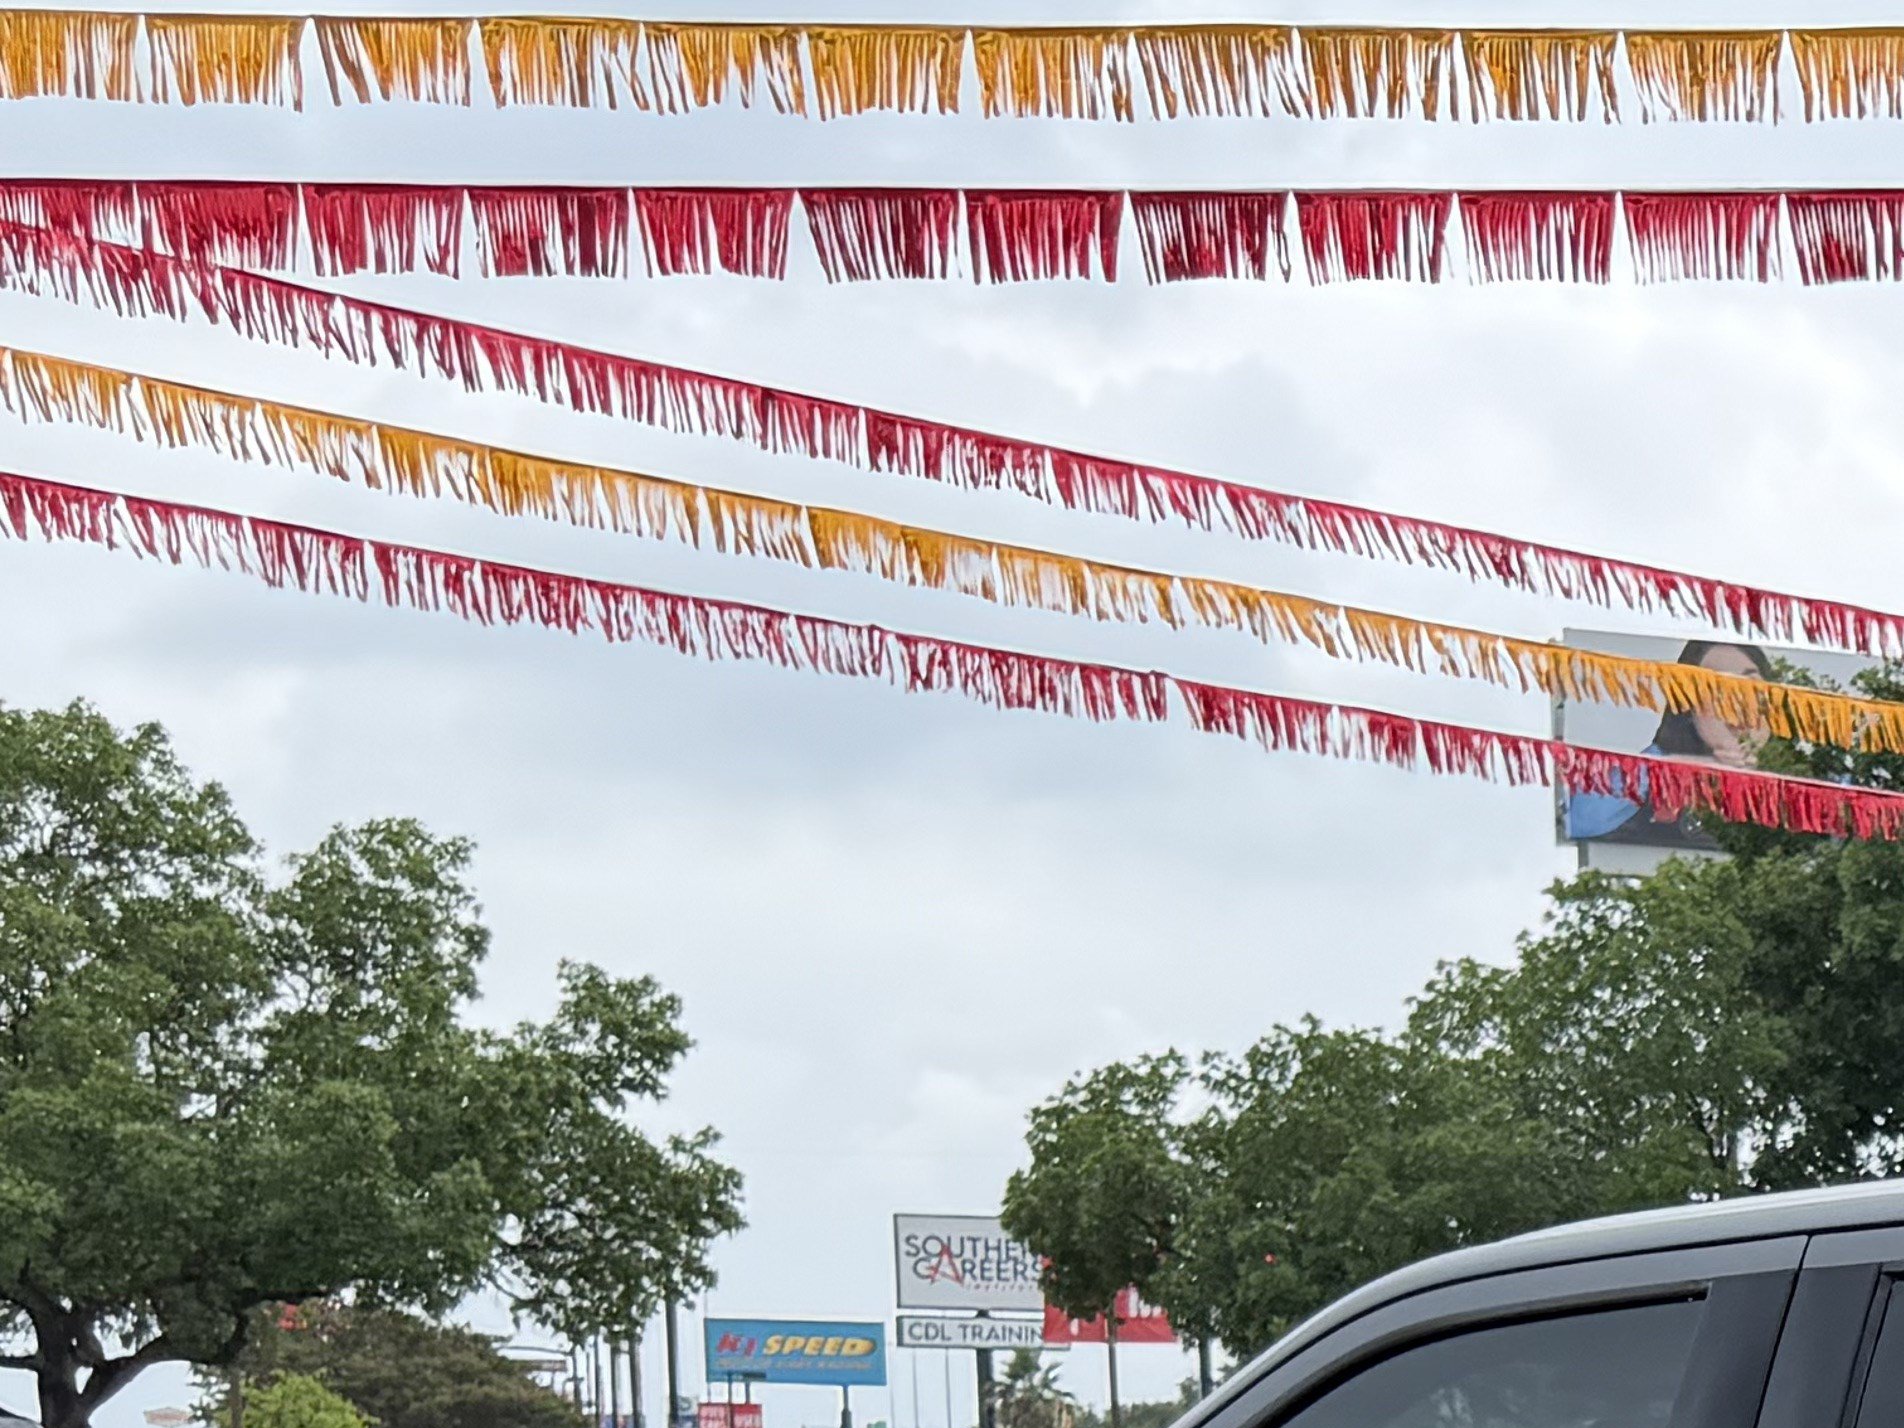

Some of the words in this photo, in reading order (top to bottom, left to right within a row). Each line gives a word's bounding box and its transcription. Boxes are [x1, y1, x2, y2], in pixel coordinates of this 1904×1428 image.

[905, 1235, 1030, 1260] SOUTHE
[908, 1322, 951, 1341] CDL
[958, 1324, 1042, 1342] TRAININ
[763, 1334, 876, 1356] SPEED
